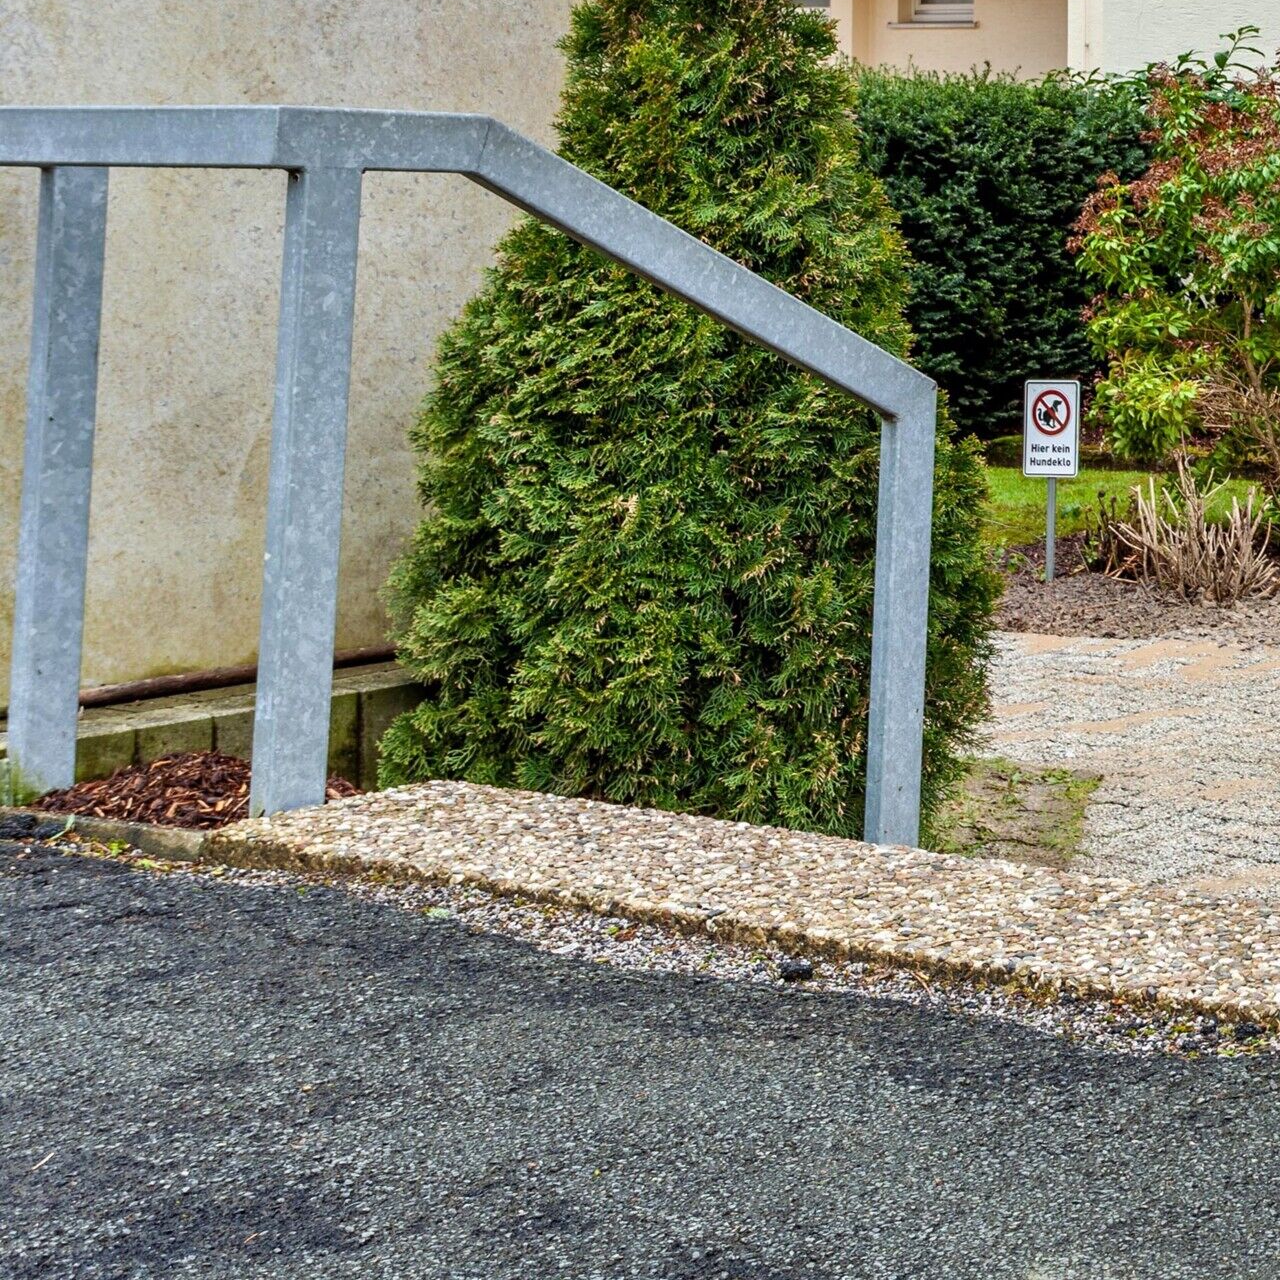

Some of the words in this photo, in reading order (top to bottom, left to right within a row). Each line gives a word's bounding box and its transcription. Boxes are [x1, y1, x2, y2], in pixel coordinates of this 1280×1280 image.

[1031, 444, 1049, 453] Hier
[1052, 444, 1070, 453] kein
[1030, 458, 1071, 467] Hundeklo
